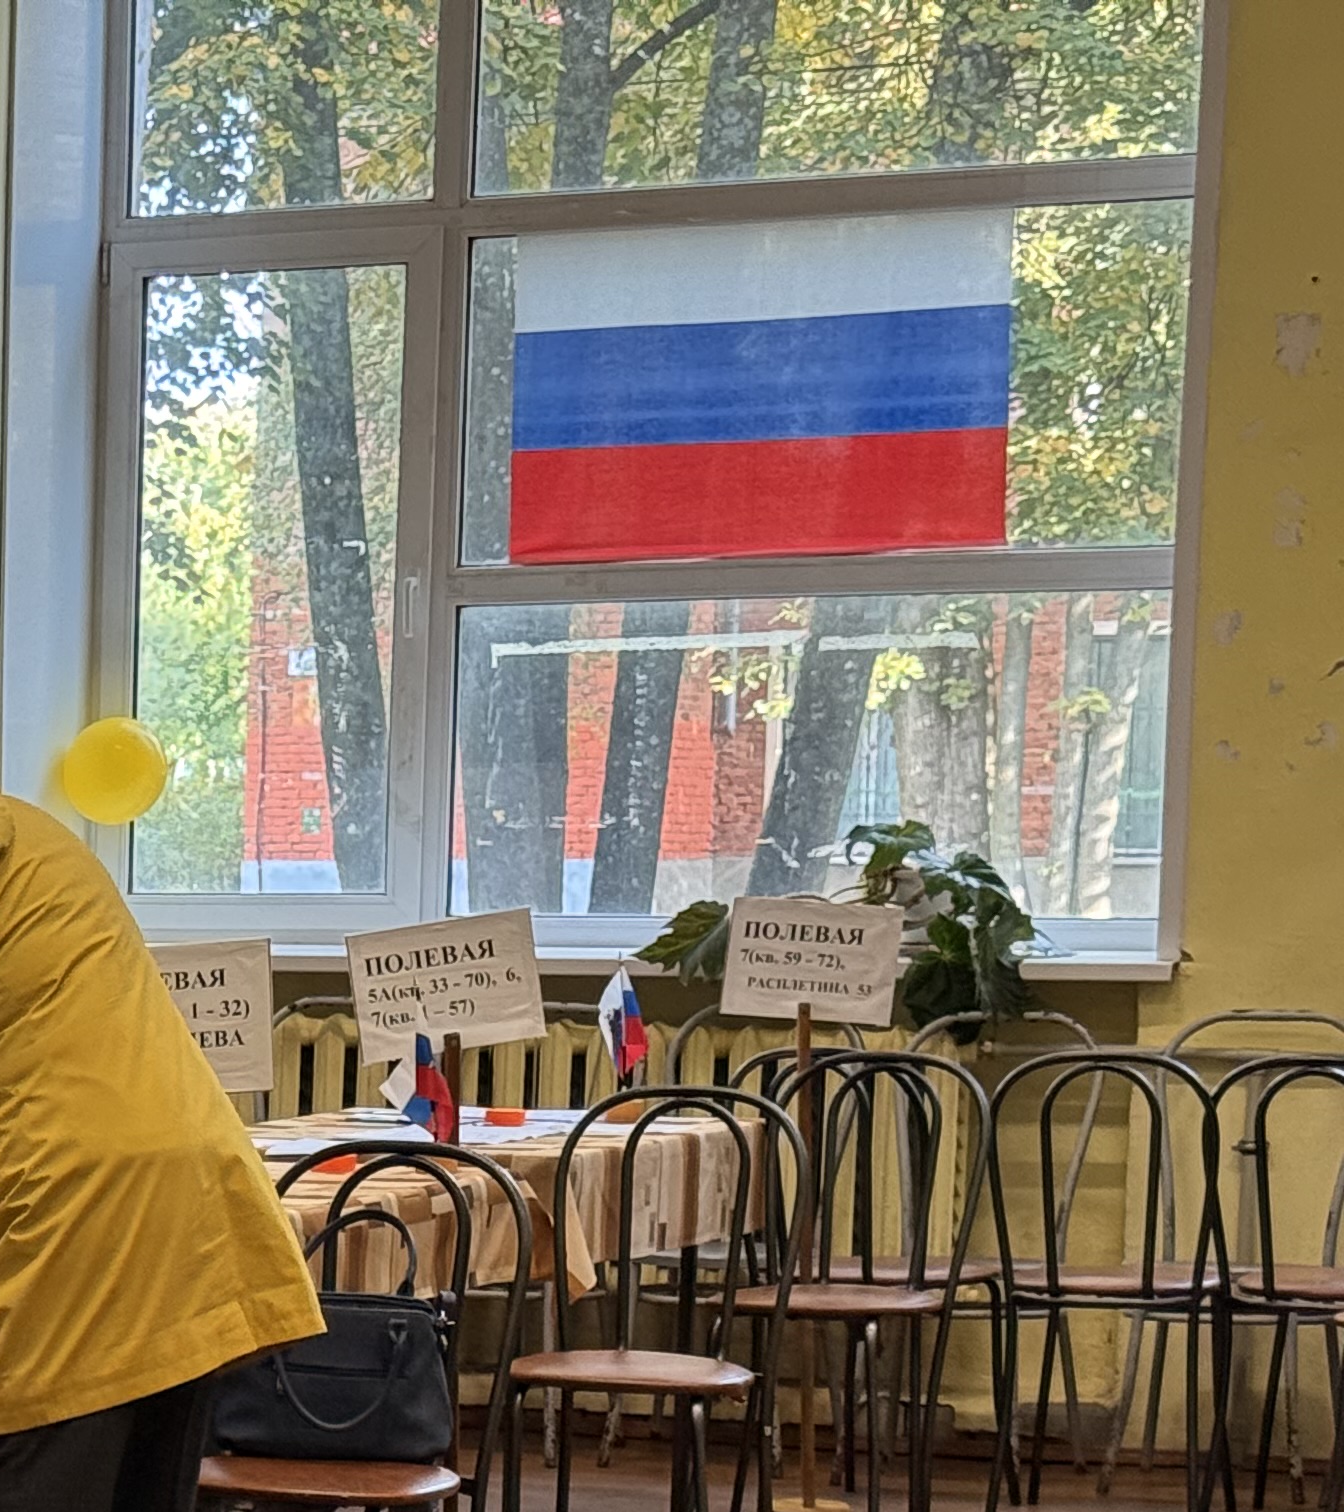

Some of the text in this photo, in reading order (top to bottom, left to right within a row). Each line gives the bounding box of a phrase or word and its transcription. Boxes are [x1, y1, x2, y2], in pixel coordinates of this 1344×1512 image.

[743, 920, 865, 945] ПОЛЕВАЯ
[364, 938, 496, 978] ПОЛЕВАЯ
[782, 950, 802, 966] 59
[428, 977, 450, 996] 33
[505, 966, 523, 984] 6,
[747, 976, 873, 996] РАСПЛЕТИНА 53
[219, 999, 250, 1020] 32)
[448, 998, 476, 1017] 57)
